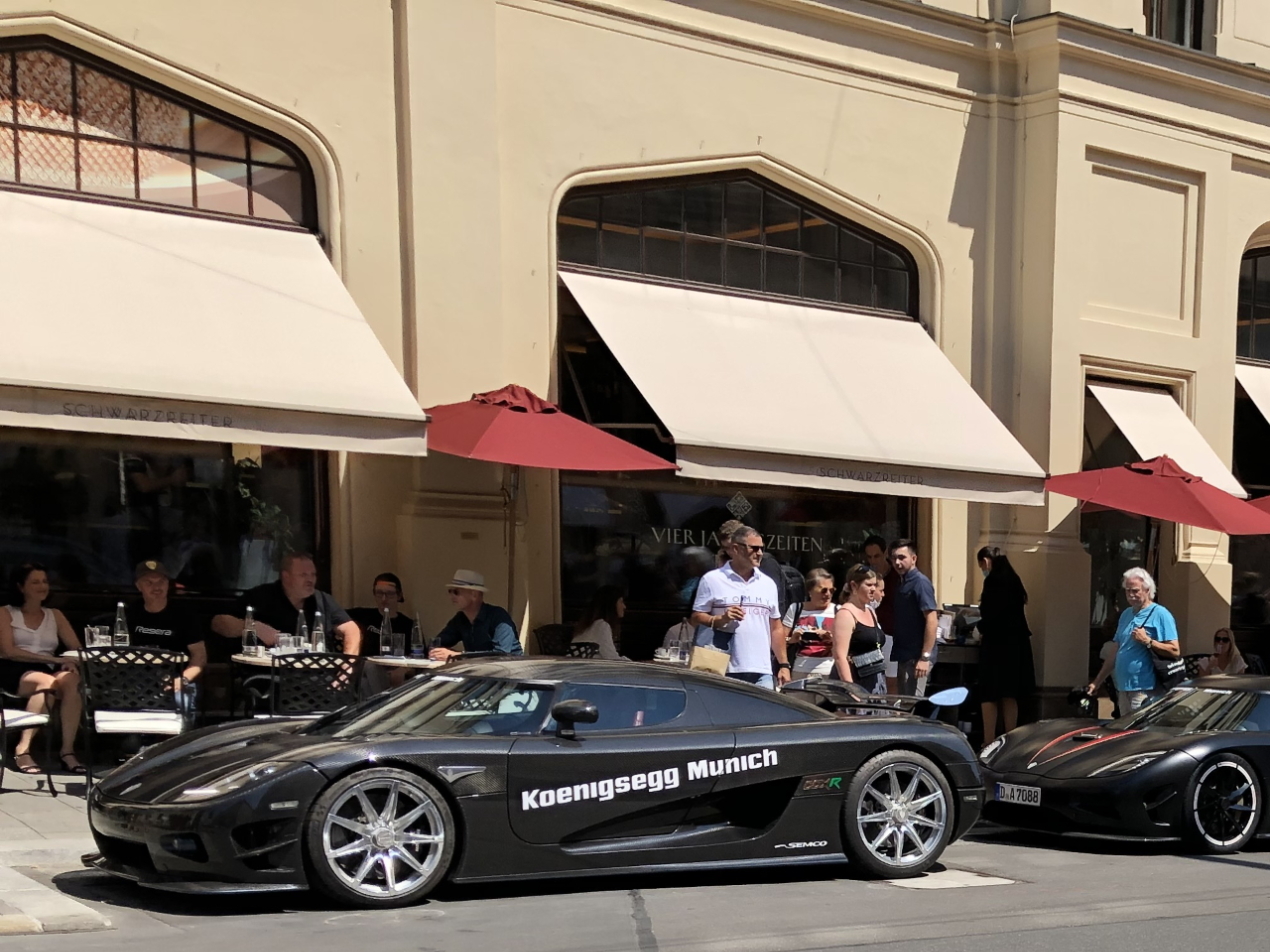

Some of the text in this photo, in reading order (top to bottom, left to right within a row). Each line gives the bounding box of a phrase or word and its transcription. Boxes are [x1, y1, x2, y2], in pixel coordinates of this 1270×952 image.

[62, 402, 234, 428] SCHWARZREITER
[818, 467, 925, 486] SCHWARZREITER
[651, 526, 696, 545] VIER
[521, 748, 779, 811] Koenigsegg Munich
[785, 840, 828, 849] SEMCO
